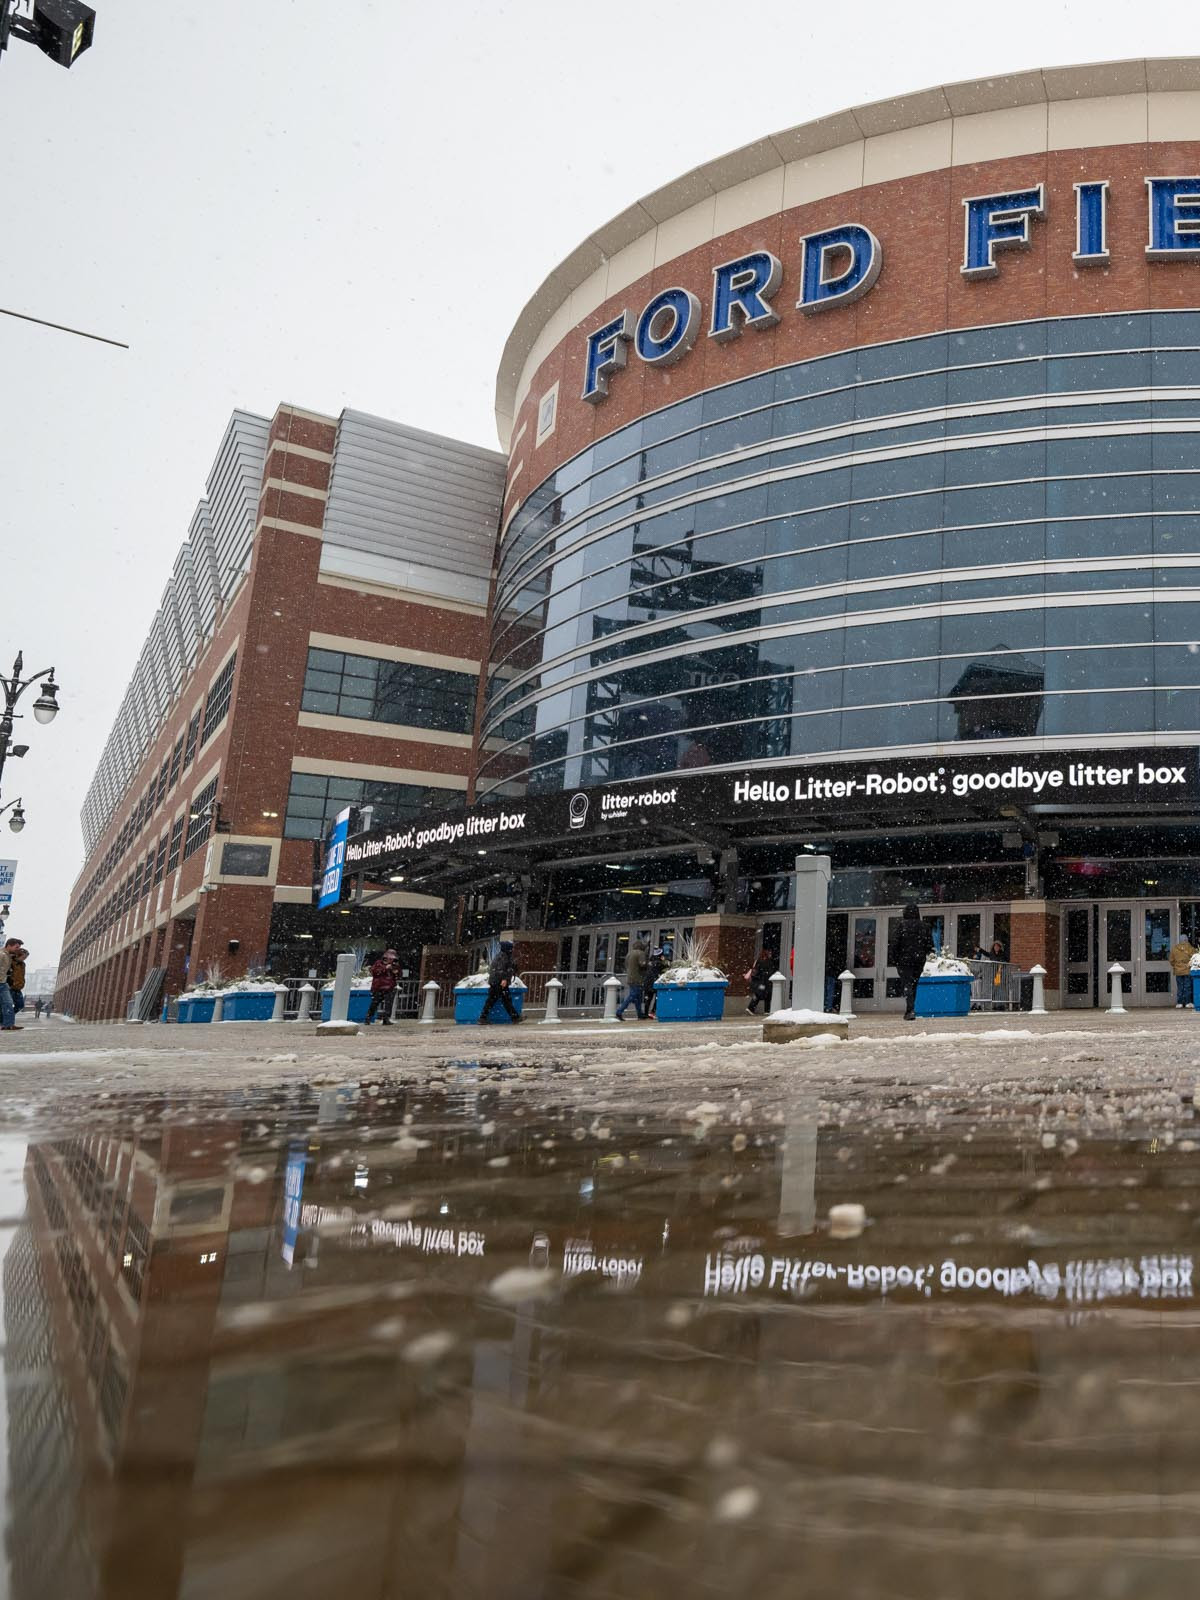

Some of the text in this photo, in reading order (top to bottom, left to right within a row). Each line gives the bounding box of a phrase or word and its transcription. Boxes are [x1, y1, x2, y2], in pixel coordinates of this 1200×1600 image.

[582, 222, 883, 404] FORD
[734, 780, 790, 801] Hello
[952, 766, 1063, 796] goodbye
[1069, 763, 1133, 786] litter
[1138, 763, 1186, 784] box
[346, 844, 362, 861] Hello
[416, 822, 464, 849] goodbye
[466, 816, 498, 836] litter
[500, 812, 526, 831] box
